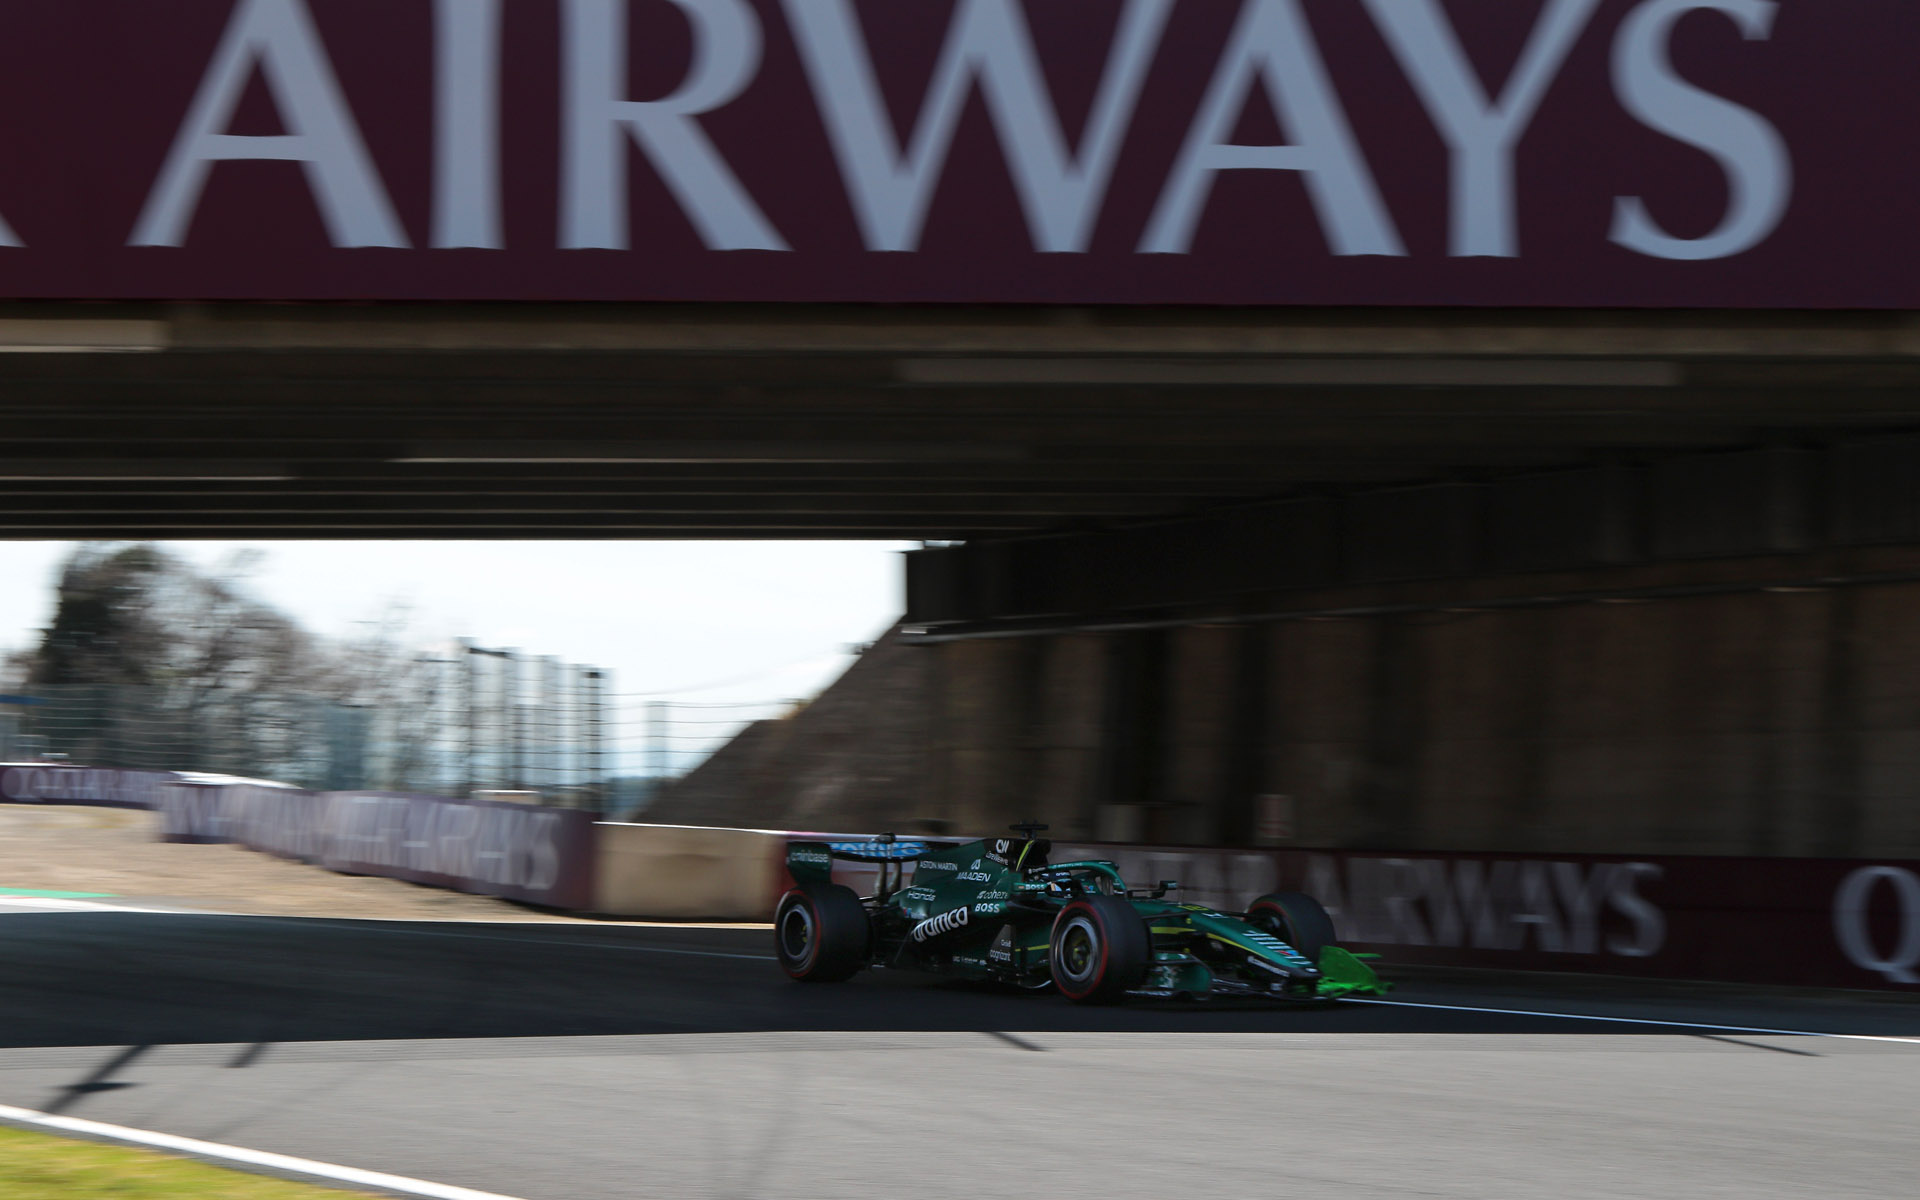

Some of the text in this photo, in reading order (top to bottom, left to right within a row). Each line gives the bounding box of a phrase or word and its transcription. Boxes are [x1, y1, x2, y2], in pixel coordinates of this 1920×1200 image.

[128, 0, 1793, 260] AIRWAYS
[920, 860, 958, 871] ASTON MARTIN
[956, 872, 991, 882] MAADEN
[975, 903, 1000, 914] BOSS
[911, 906, 969, 942] aramco
